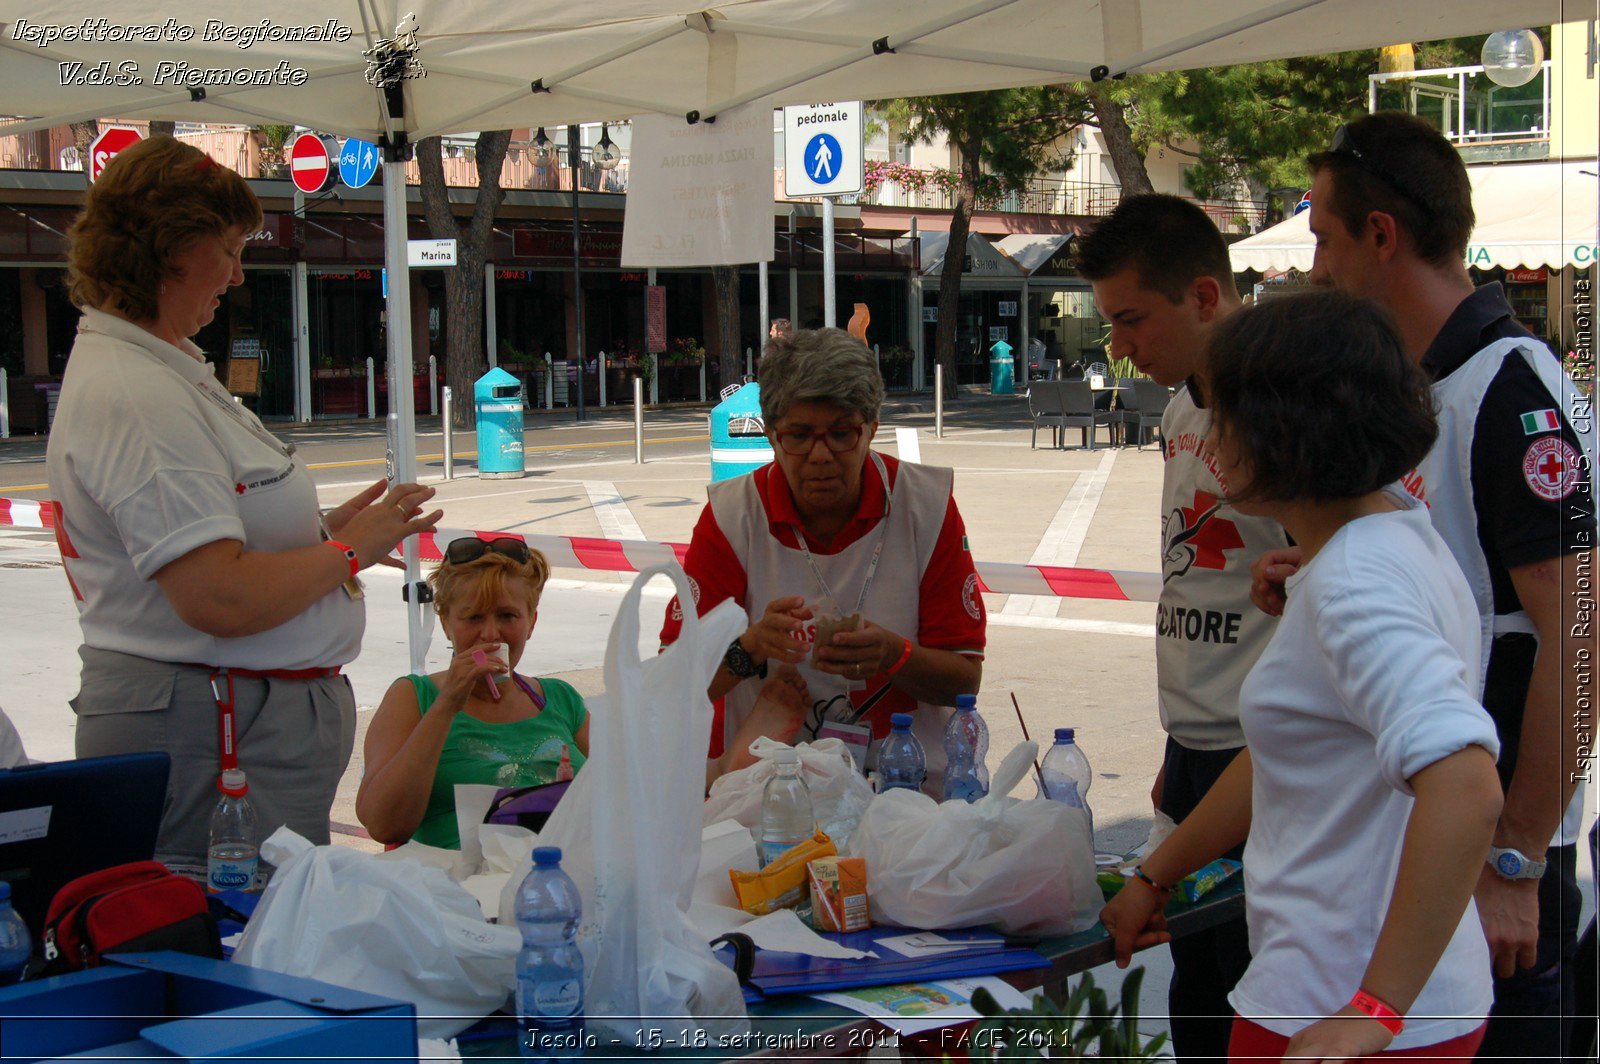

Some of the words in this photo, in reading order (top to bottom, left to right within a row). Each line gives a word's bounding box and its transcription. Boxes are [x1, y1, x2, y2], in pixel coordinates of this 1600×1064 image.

[797, 110, 848, 127] pedonale
[421, 250, 452, 260] Marina
[967, 259, 998, 270] FASHION
